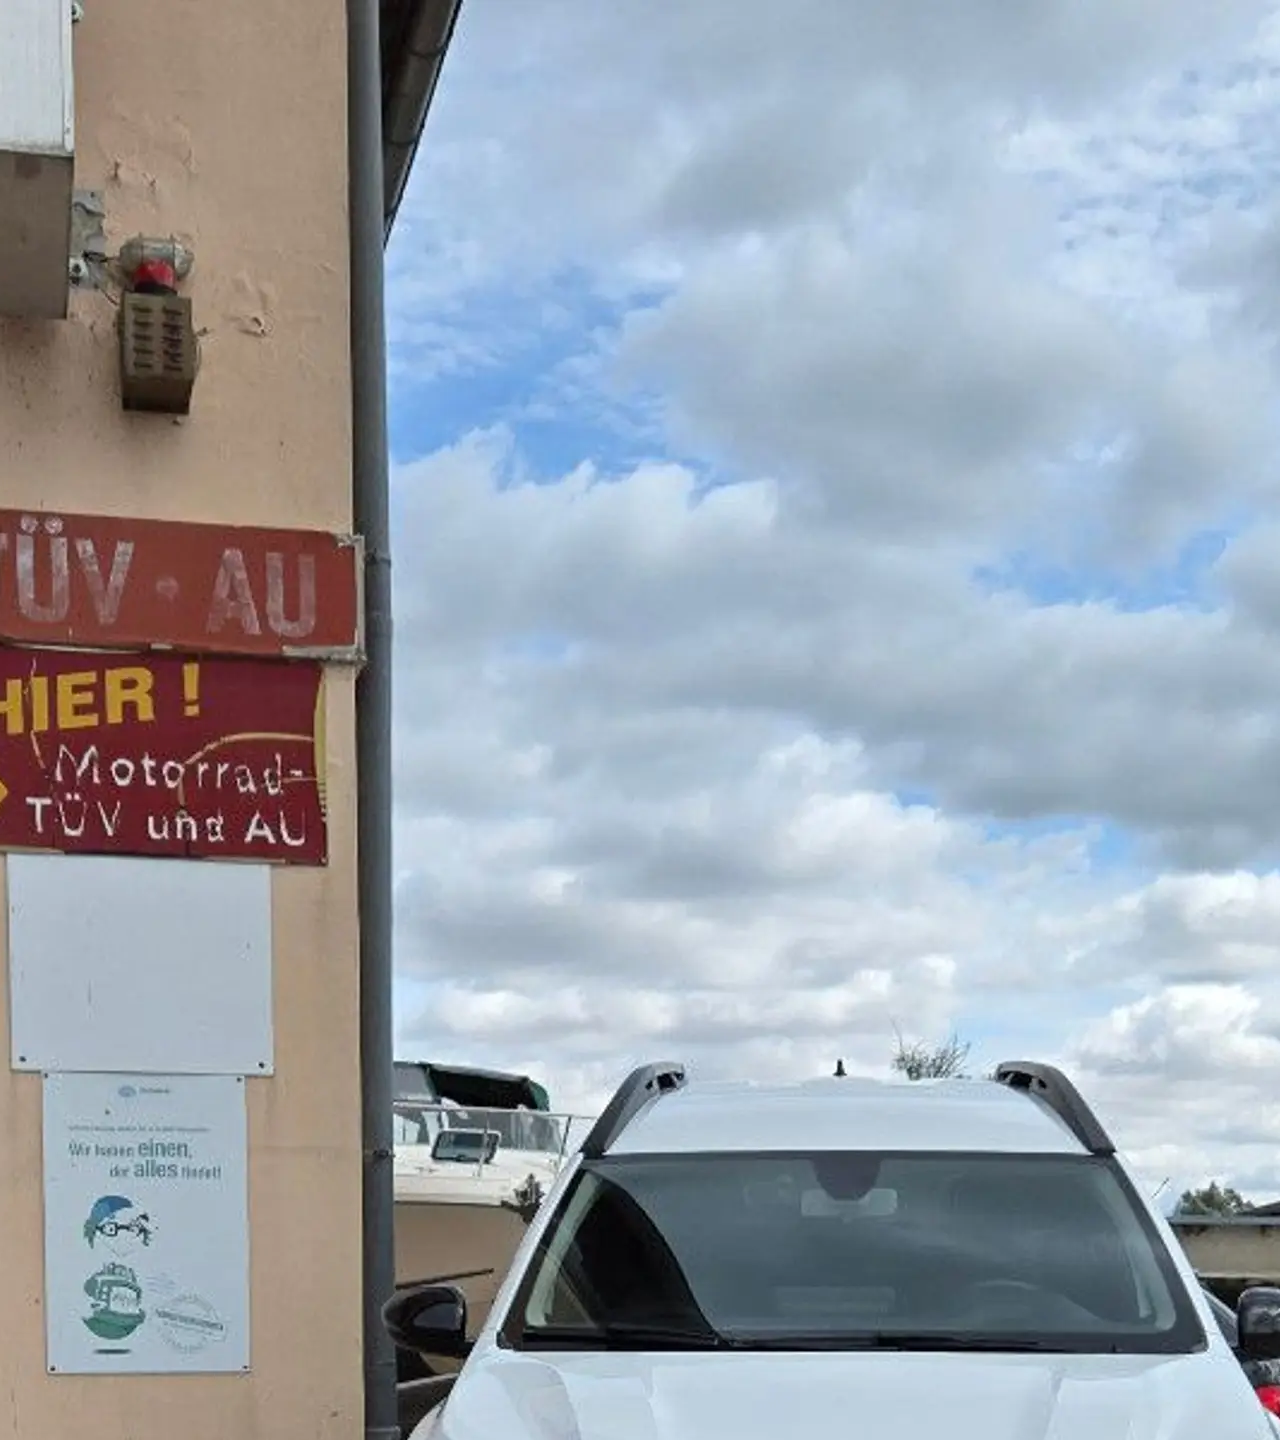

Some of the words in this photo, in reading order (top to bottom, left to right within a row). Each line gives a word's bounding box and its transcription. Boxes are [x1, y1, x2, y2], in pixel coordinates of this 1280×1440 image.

[207, 547, 316, 638] AU
[183, 663, 200, 717] !
[26, 794, 120, 836] TÜV
[148, 811, 224, 843] und
[244, 811, 306, 846] AU
[133, 1159, 178, 1178] alles
